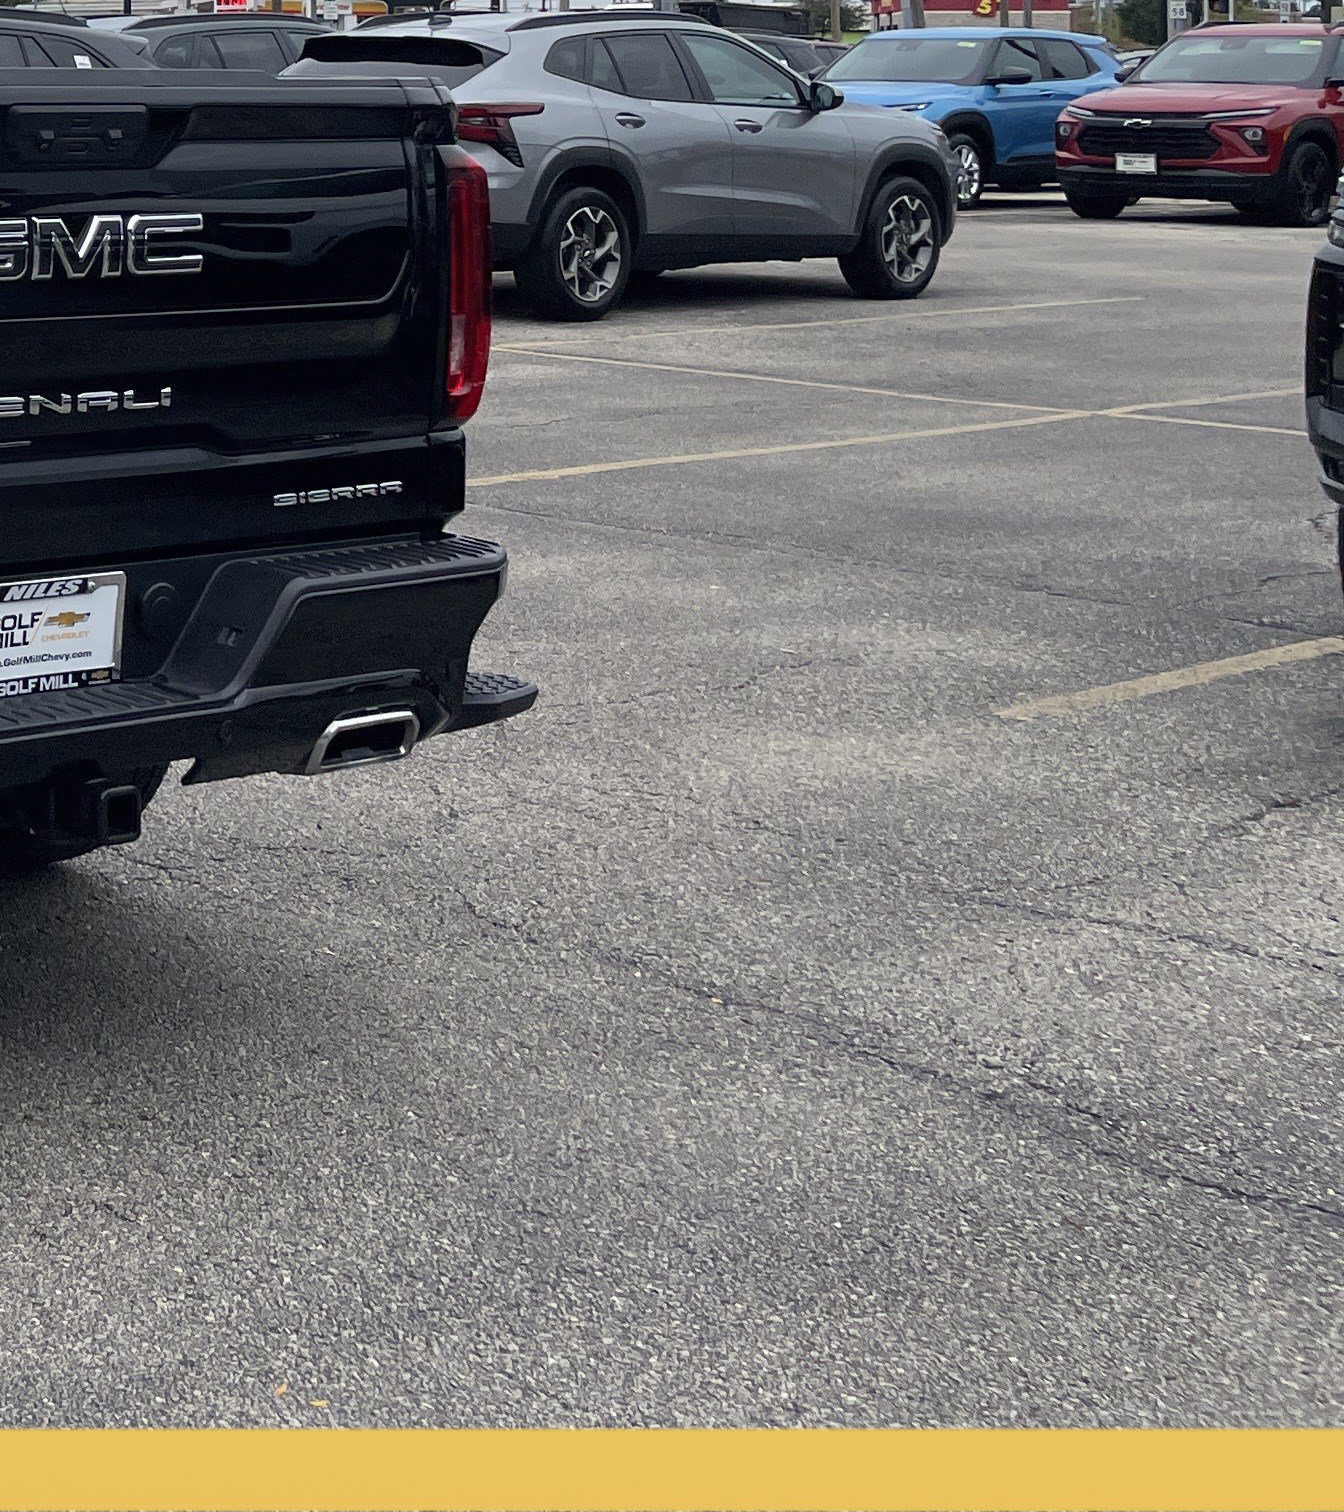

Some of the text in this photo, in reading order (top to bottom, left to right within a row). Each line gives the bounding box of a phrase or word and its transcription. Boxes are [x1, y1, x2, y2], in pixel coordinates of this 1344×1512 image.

[273, 480, 403, 507] SIERRA
[3, 579, 84, 602] NILES
[39, 672, 79, 692] MILL
